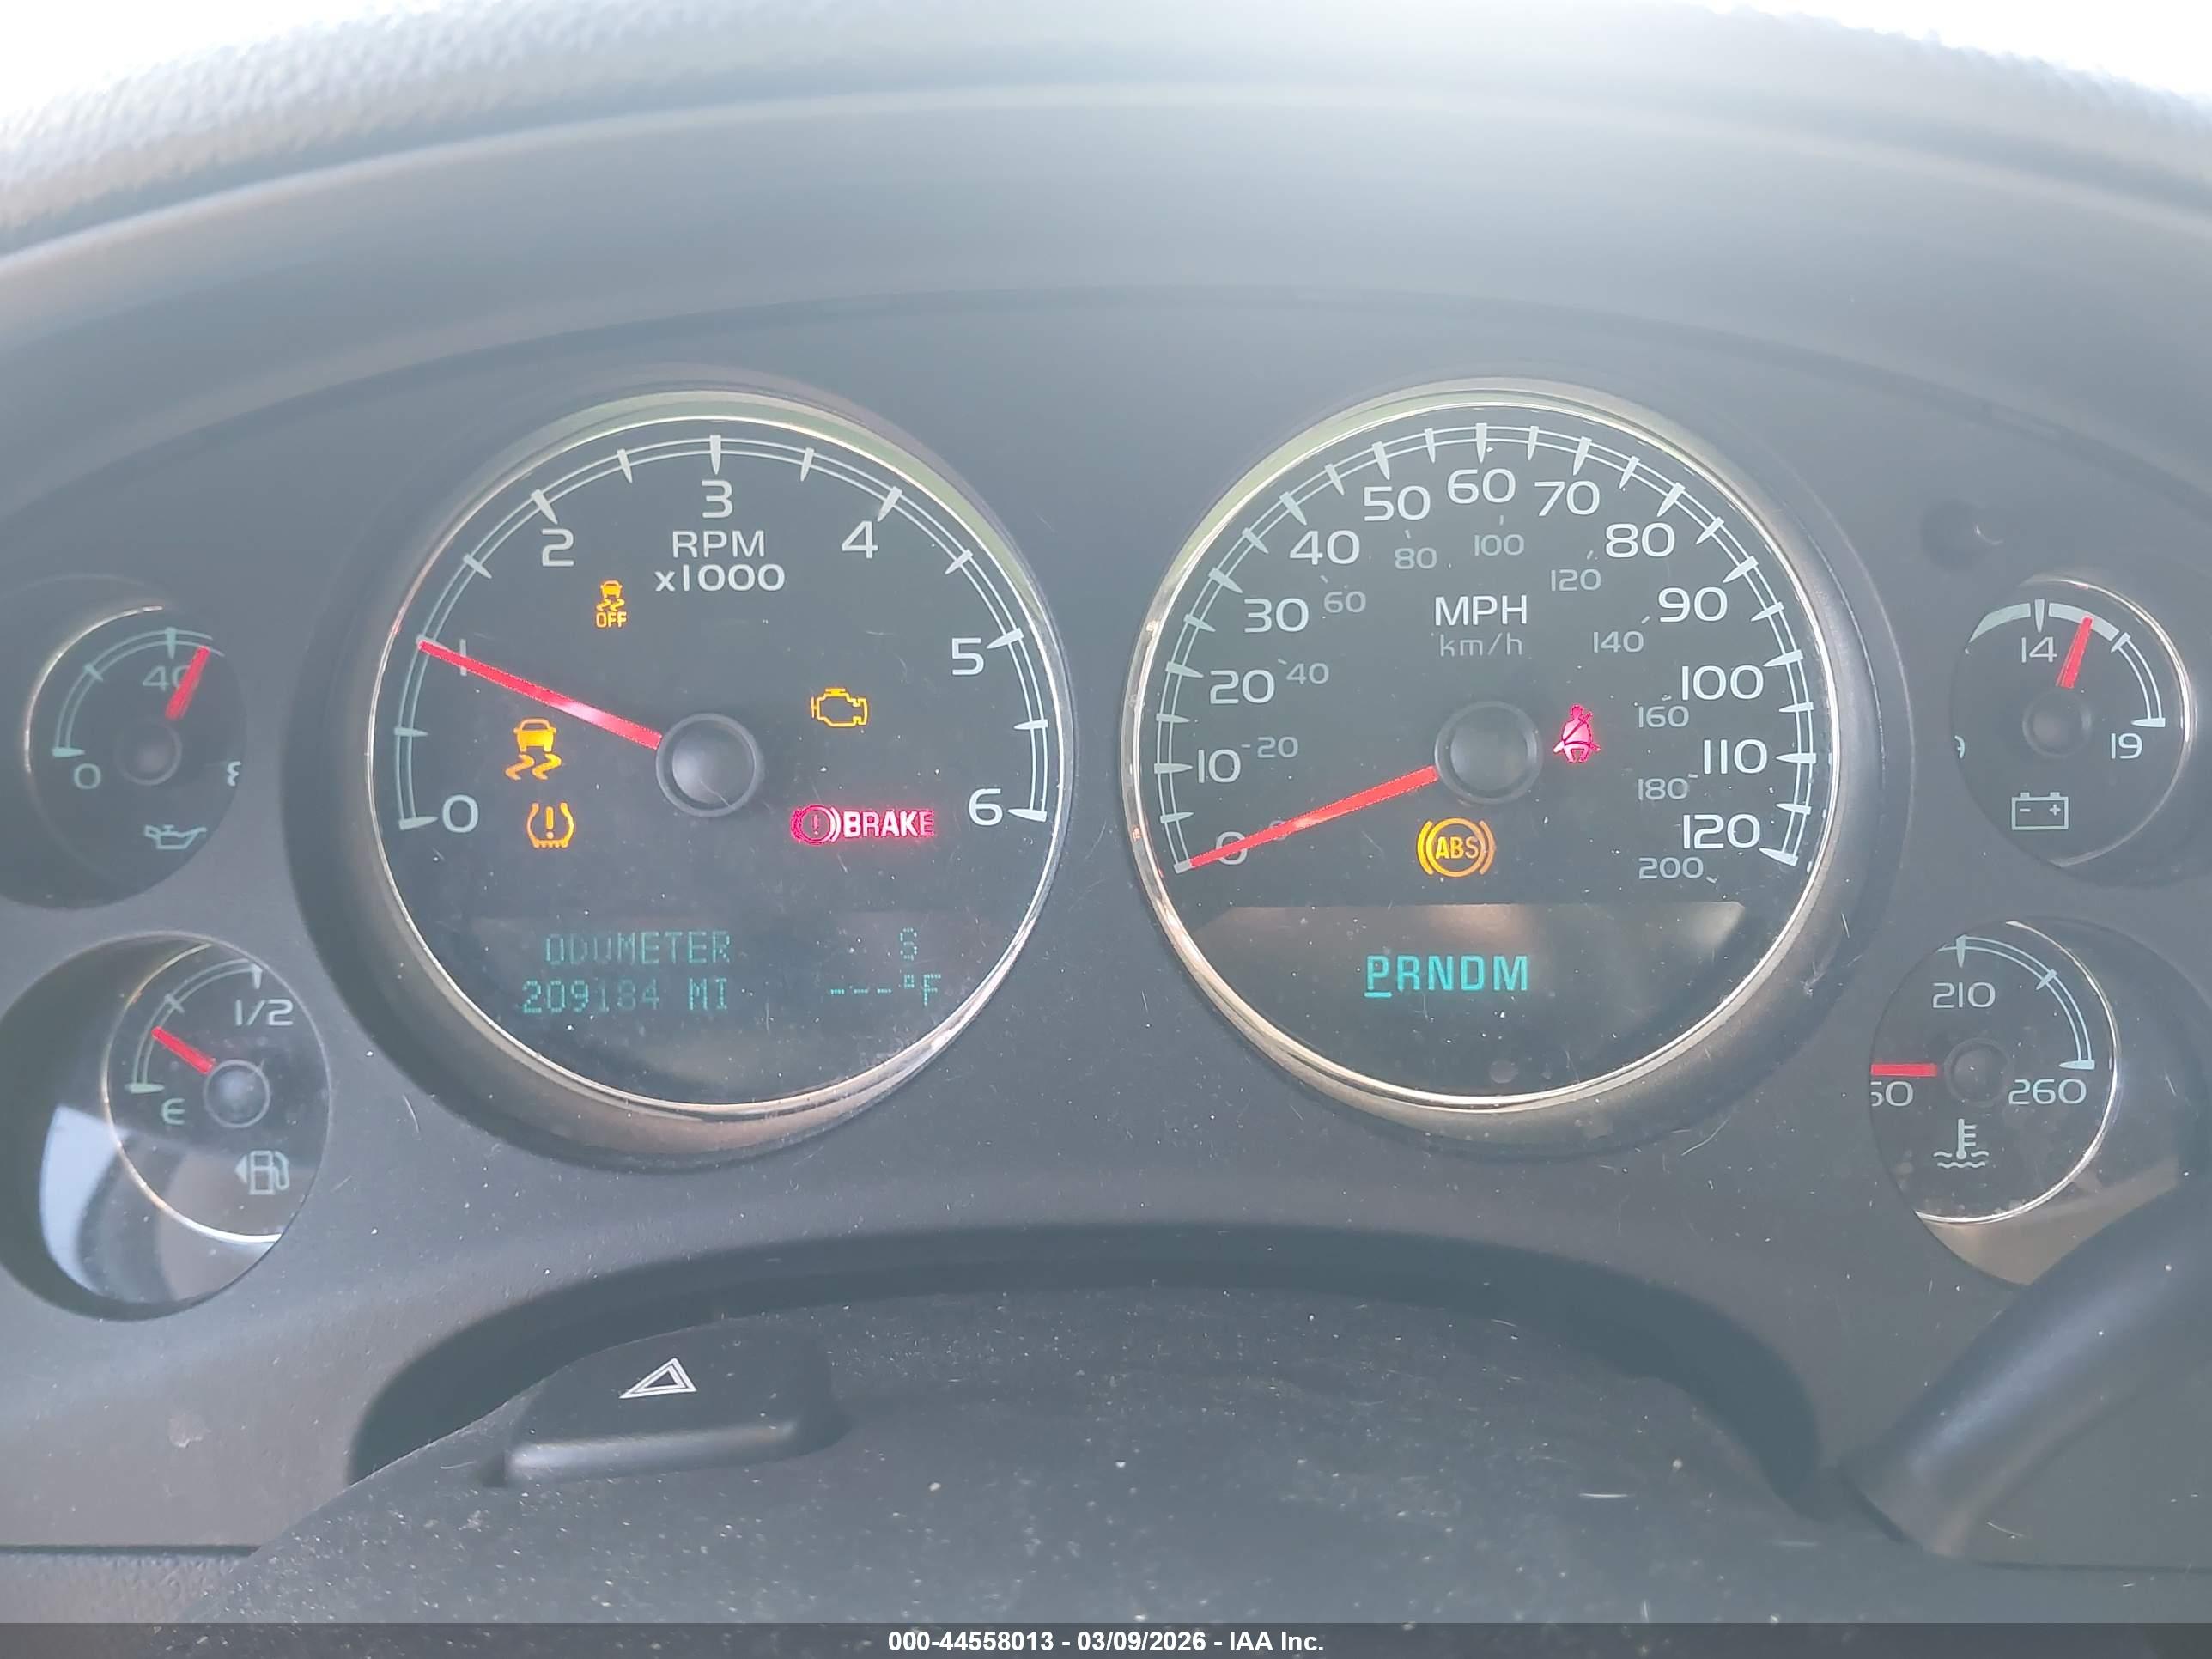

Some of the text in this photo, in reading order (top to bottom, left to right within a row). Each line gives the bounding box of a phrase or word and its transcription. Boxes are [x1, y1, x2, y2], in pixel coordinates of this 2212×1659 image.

[702, 480, 733, 519] 3
[1447, 469, 1516, 504] 60
[1534, 481, 1601, 517] 70
[1364, 486, 1431, 522] 50
[542, 529, 574, 567] 2
[672, 530, 765, 558] RPM
[842, 521, 878, 559] 4
[1289, 530, 1360, 566] 40
[1474, 534, 1525, 557] 100
[1605, 522, 1675, 558] 80
[1394, 547, 1438, 570] 80
[654, 563, 786, 592] x1000
[1550, 568, 1601, 592] 120
[1243, 597, 1309, 634] 30
[1323, 591, 1366, 613] 60
[1434, 594, 1528, 626] MPH
[1657, 586, 1729, 623] 90
[595, 611, 628, 628] OFF
[1439, 633, 1523, 657] km/h
[1593, 630, 1644, 653] 140
[2021, 636, 2057, 663] 14
[951, 637, 984, 676] 5
[1209, 670, 1275, 704] 20
[1286, 662, 1330, 685] 40
[1680, 665, 1765, 701] 100
[1638, 705, 1689, 728] 160
[1257, 736, 1299, 758] 20
[1703, 739, 1768, 775] 110
[2110, 732, 2143, 760] 19
[74, 763, 102, 790] 0
[1198, 749, 1242, 784] 10
[1638, 778, 1689, 800] 180
[442, 794, 479, 833] 0
[969, 788, 1004, 826] 6
[843, 810, 935, 837] BRAKE
[1682, 814, 1760, 849] 120
[1435, 836, 1480, 860] ABS
[1638, 857, 1704, 880] 200
[688, 977, 728, 1011] MI
[1932, 981, 1996, 1009] 210
[235, 999, 294, 1027] 1/2
[2008, 1079, 2087, 1105] 260
